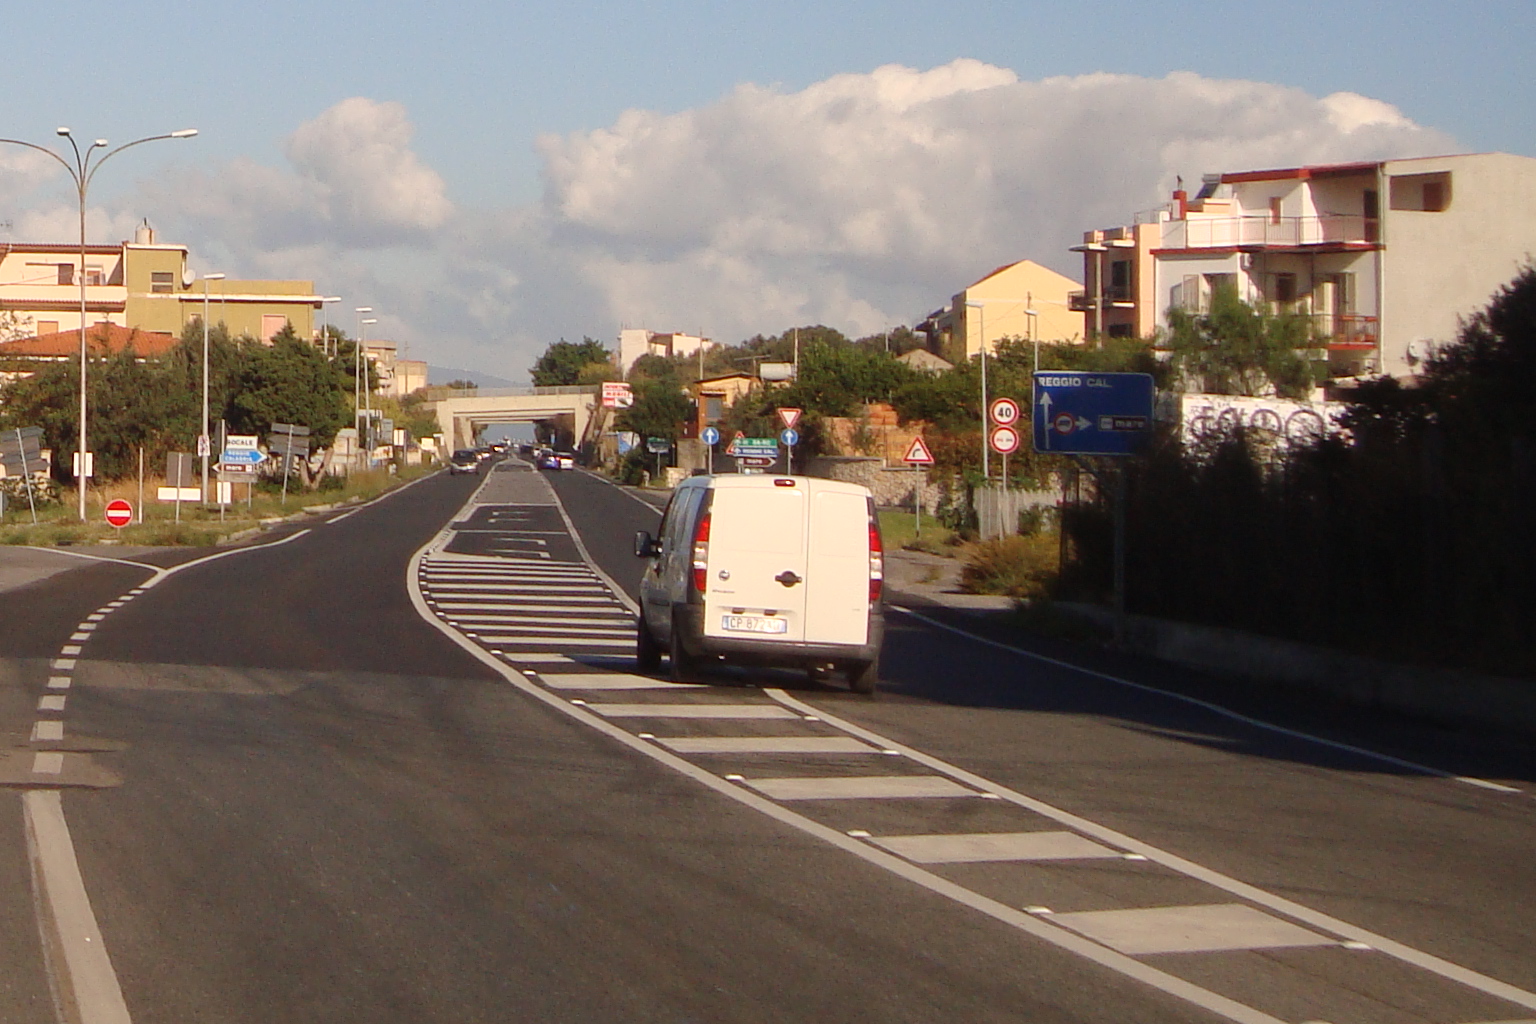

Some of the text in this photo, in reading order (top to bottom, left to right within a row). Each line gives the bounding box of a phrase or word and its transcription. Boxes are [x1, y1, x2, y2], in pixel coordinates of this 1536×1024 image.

[1038, 377, 1082, 387] REGGIO
[997, 407, 1012, 418] 40
[1115, 420, 1144, 429] mare
